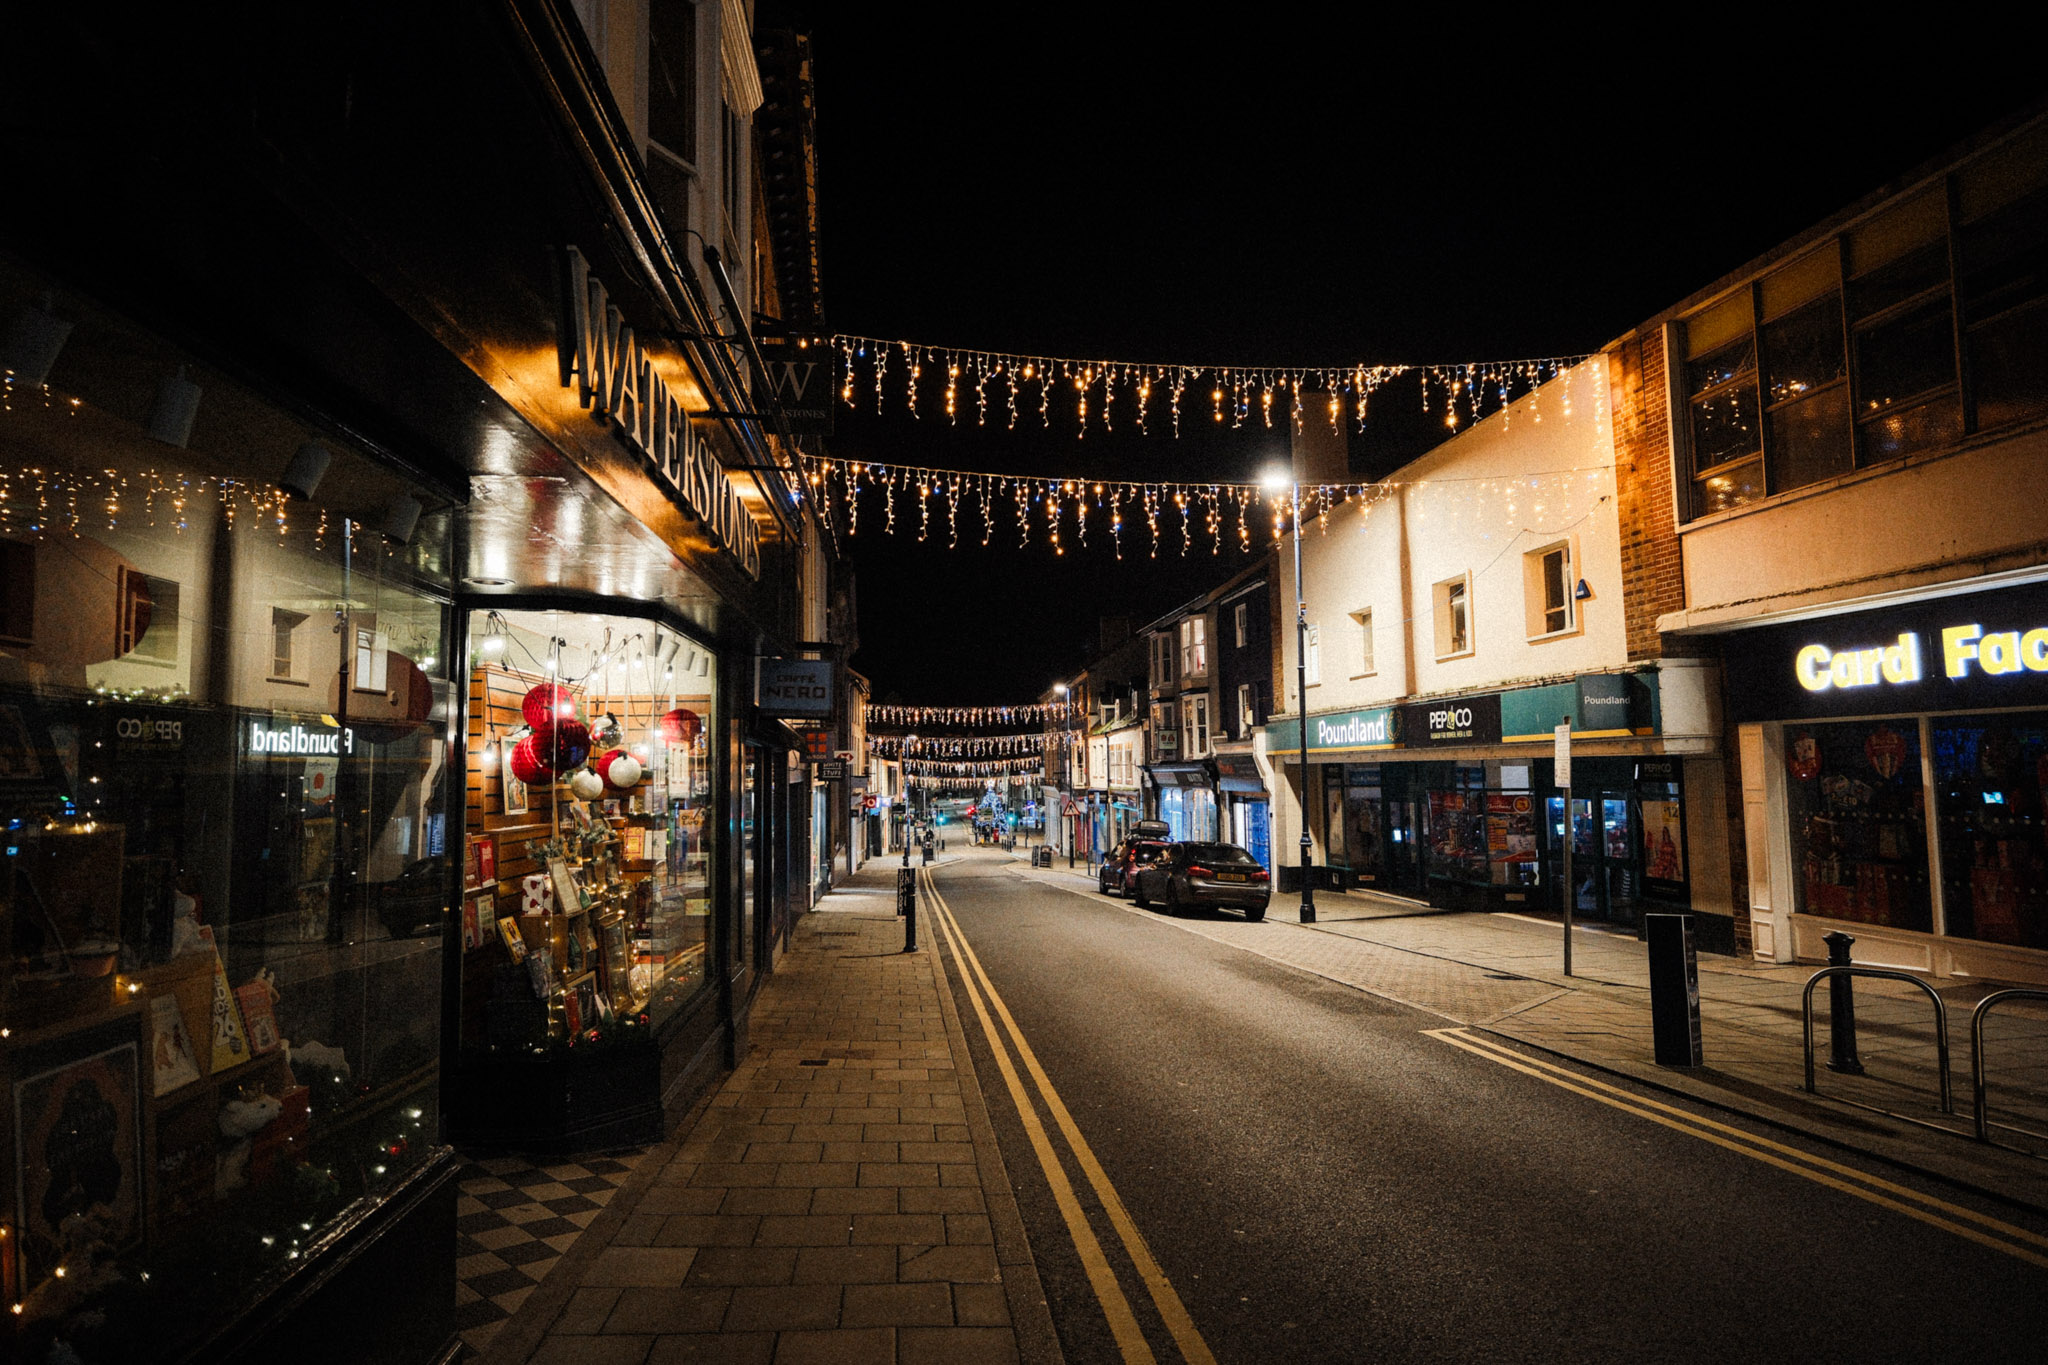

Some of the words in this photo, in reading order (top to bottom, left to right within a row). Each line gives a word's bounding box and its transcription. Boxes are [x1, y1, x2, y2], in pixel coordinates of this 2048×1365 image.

[764, 361, 818, 401] W
[548, 245, 761, 582] WATERSTONES
[1795, 631, 1921, 692] Card
[765, 686, 826, 699] NERO
[1583, 695, 1631, 705] Poundland
[1318, 714, 1385, 745] Poundland
